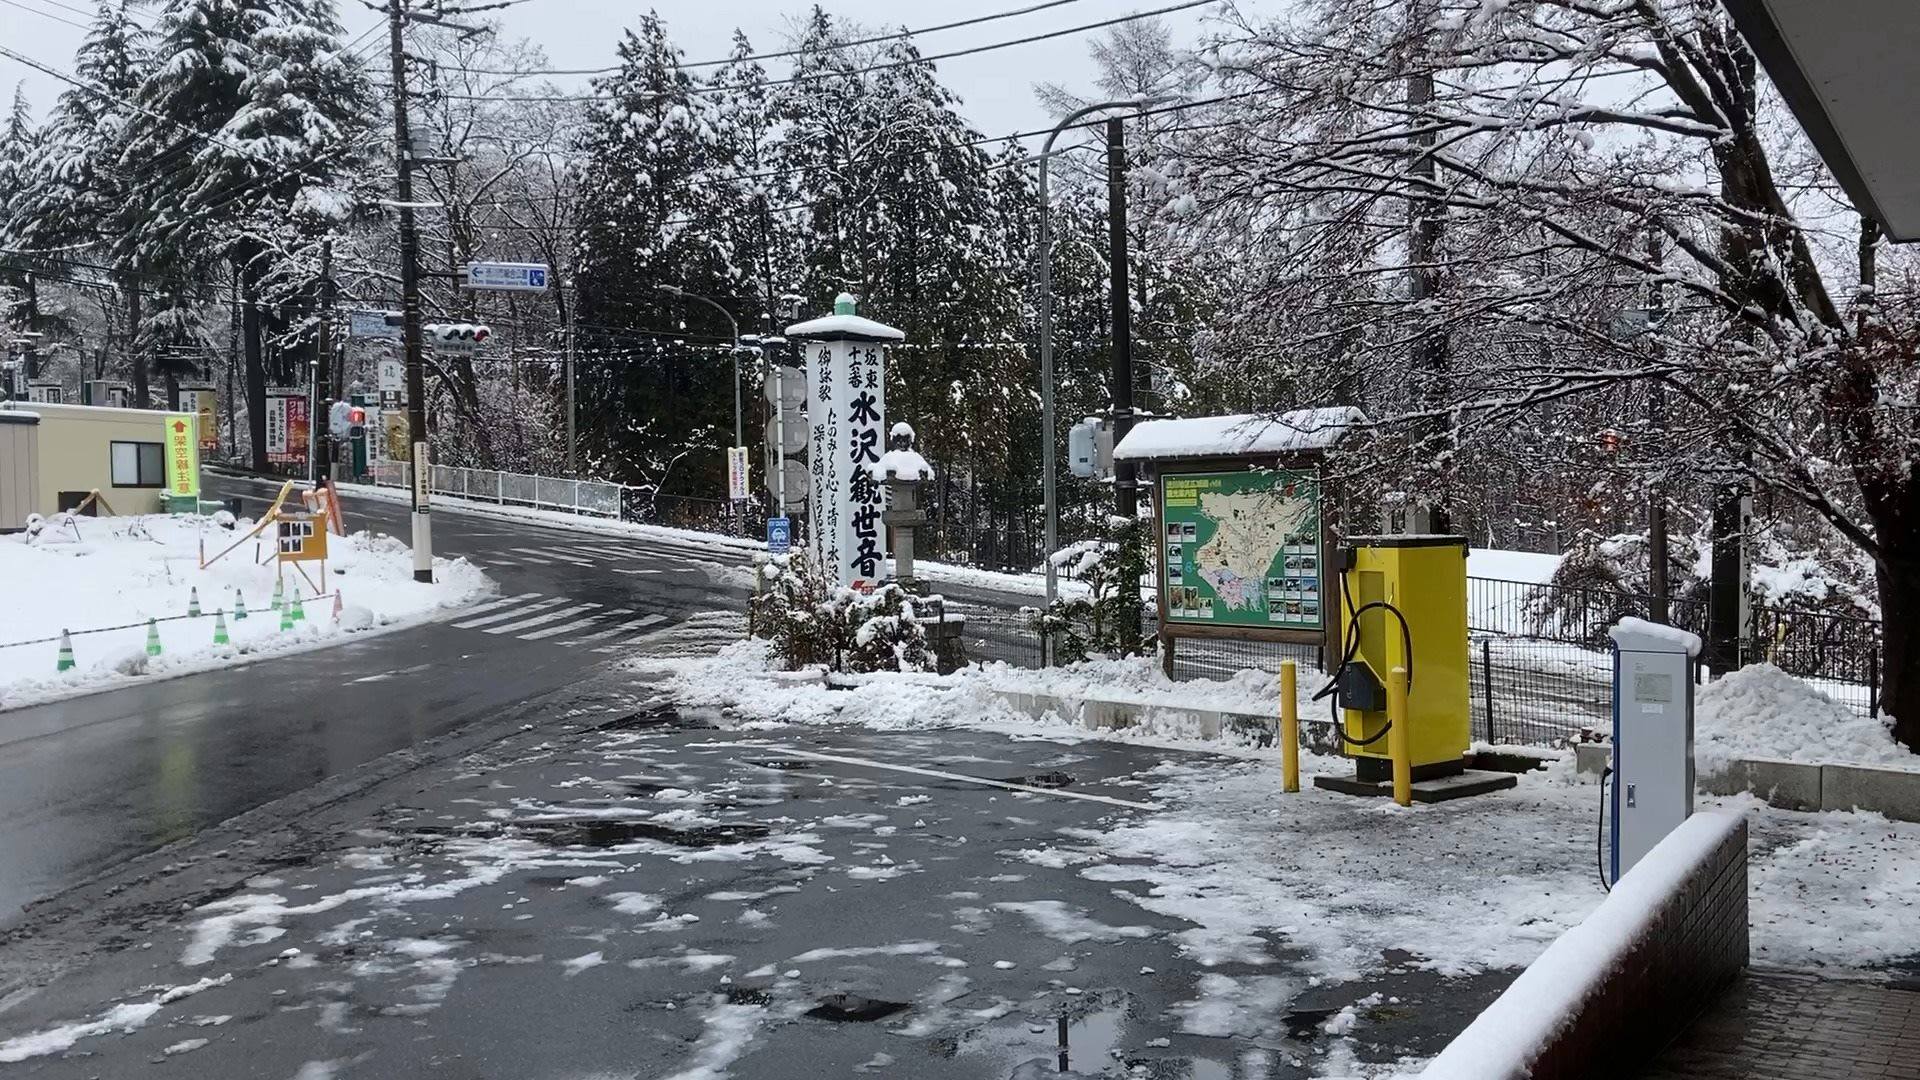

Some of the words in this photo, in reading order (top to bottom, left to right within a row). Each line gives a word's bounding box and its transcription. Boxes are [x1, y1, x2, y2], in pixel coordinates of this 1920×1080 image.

[848, 346, 862, 388] 十六番
[864, 348, 879, 389] 坂東
[848, 391, 882, 577] 水沢観世音
